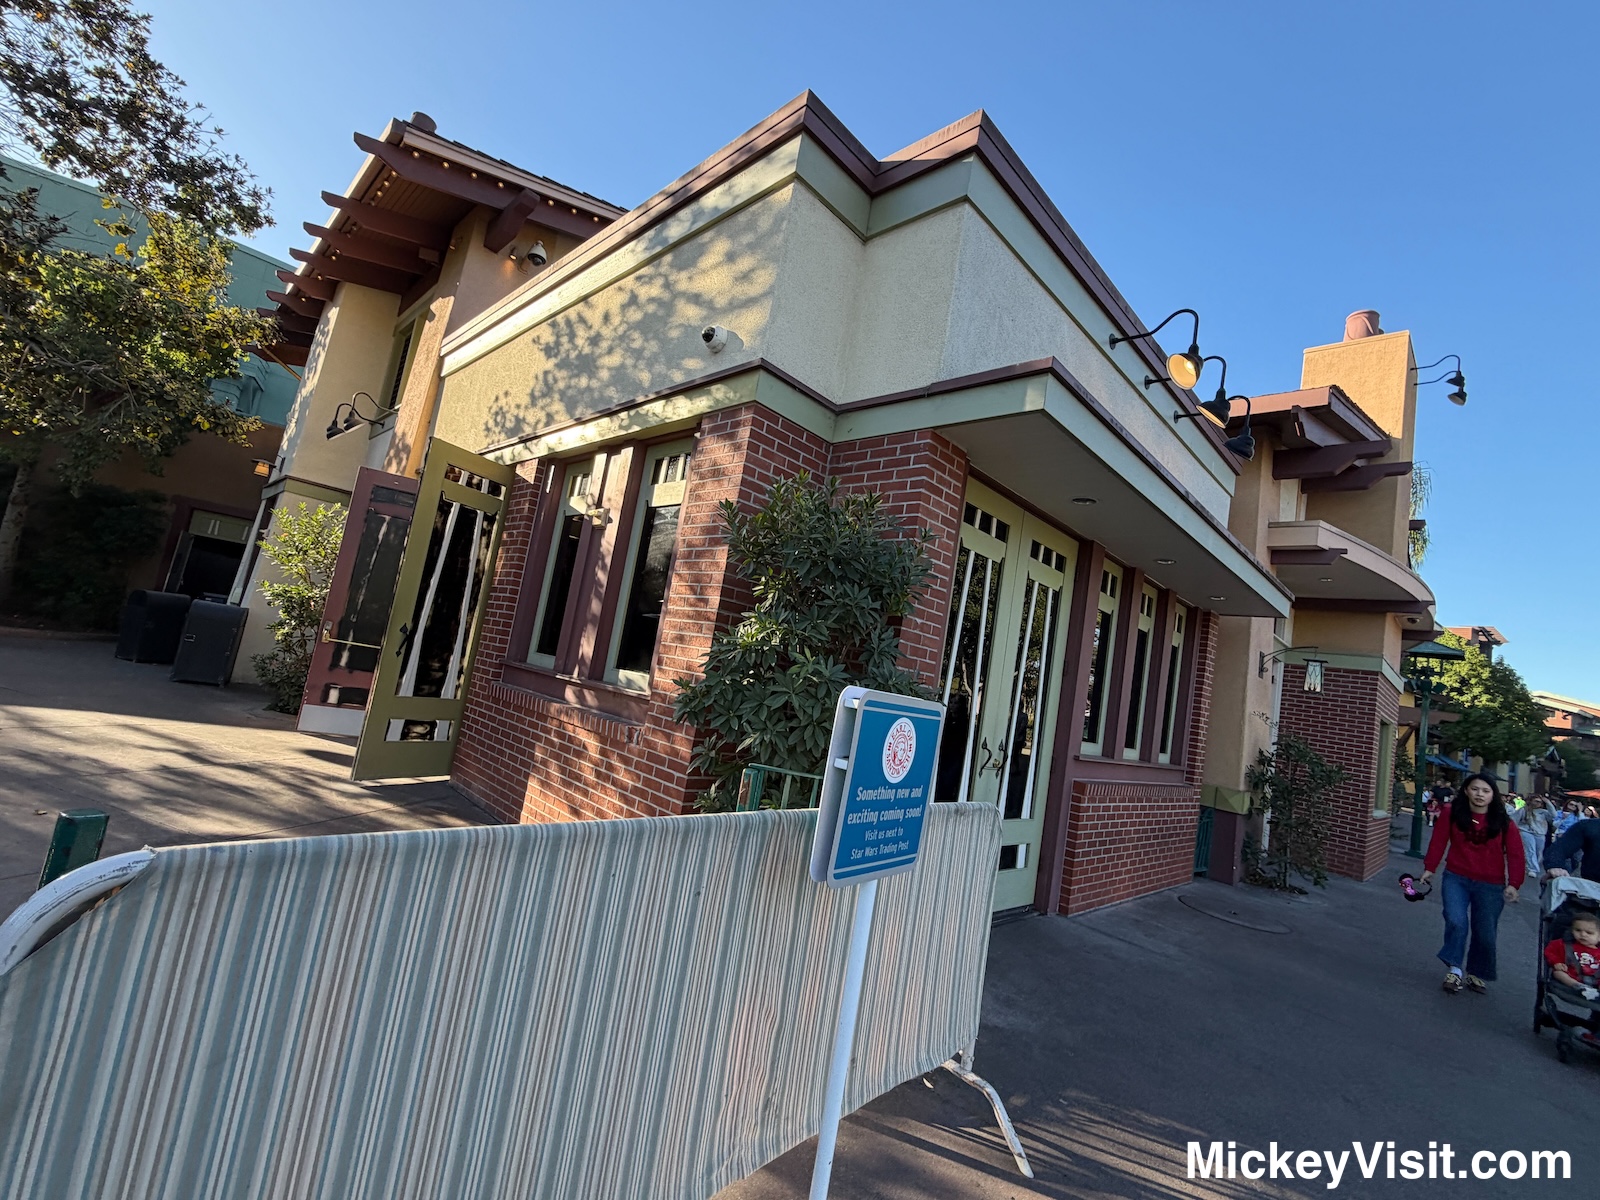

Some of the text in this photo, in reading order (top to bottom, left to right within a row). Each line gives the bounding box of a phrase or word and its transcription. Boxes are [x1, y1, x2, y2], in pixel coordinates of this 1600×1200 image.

[891, 724, 906, 740] EARL
[856, 785, 923, 802] Something new and
[847, 804, 922, 825] exciting coming soon!
[865, 826, 904, 841] Visit us next to
[850, 840, 909, 859] Star Wars Trading Post
